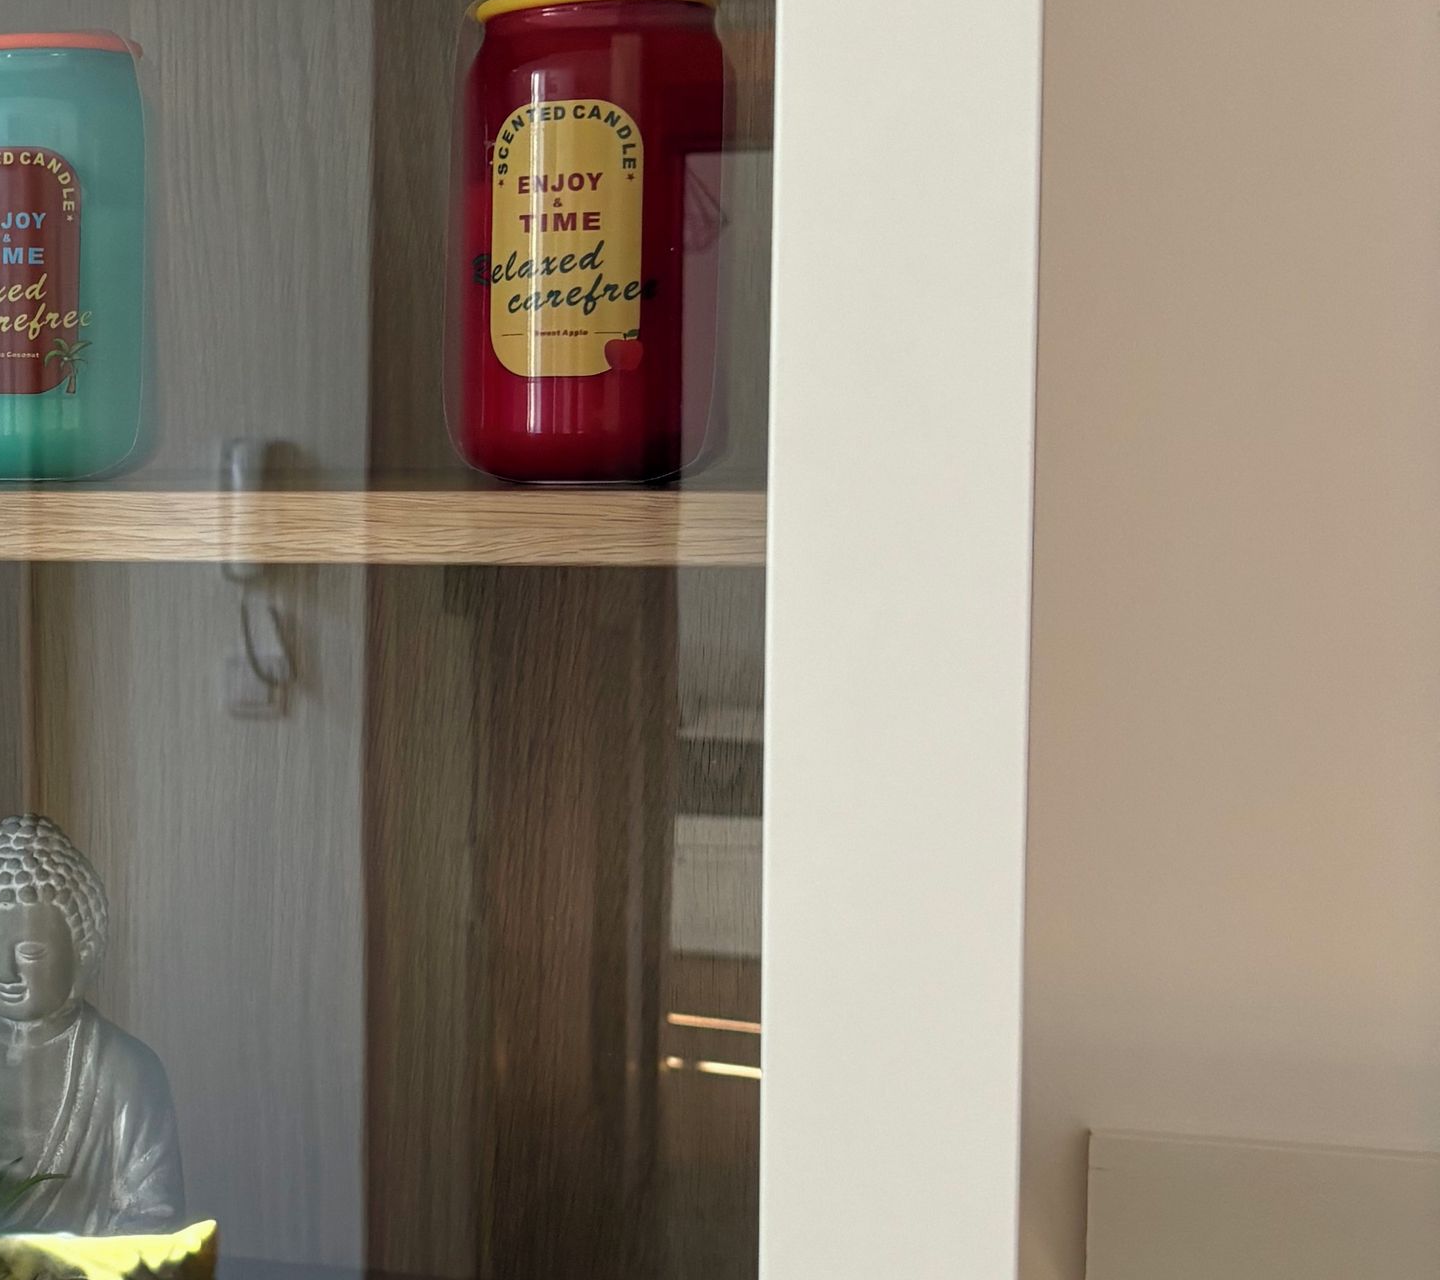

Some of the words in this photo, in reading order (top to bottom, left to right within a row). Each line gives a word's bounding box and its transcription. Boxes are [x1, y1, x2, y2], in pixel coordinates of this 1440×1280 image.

[498, 105, 565, 175] SCENTED
[573, 104, 637, 170] CANDLE
[20, 151, 75, 212] CANDLE
[518, 172, 604, 195] ENJOY
[554, 198, 563, 208] &
[3, 233, 11, 243] &
[519, 212, 601, 233] TIME
[472, 239, 605, 286] Relaxed
[507, 273, 658, 316] carefree
